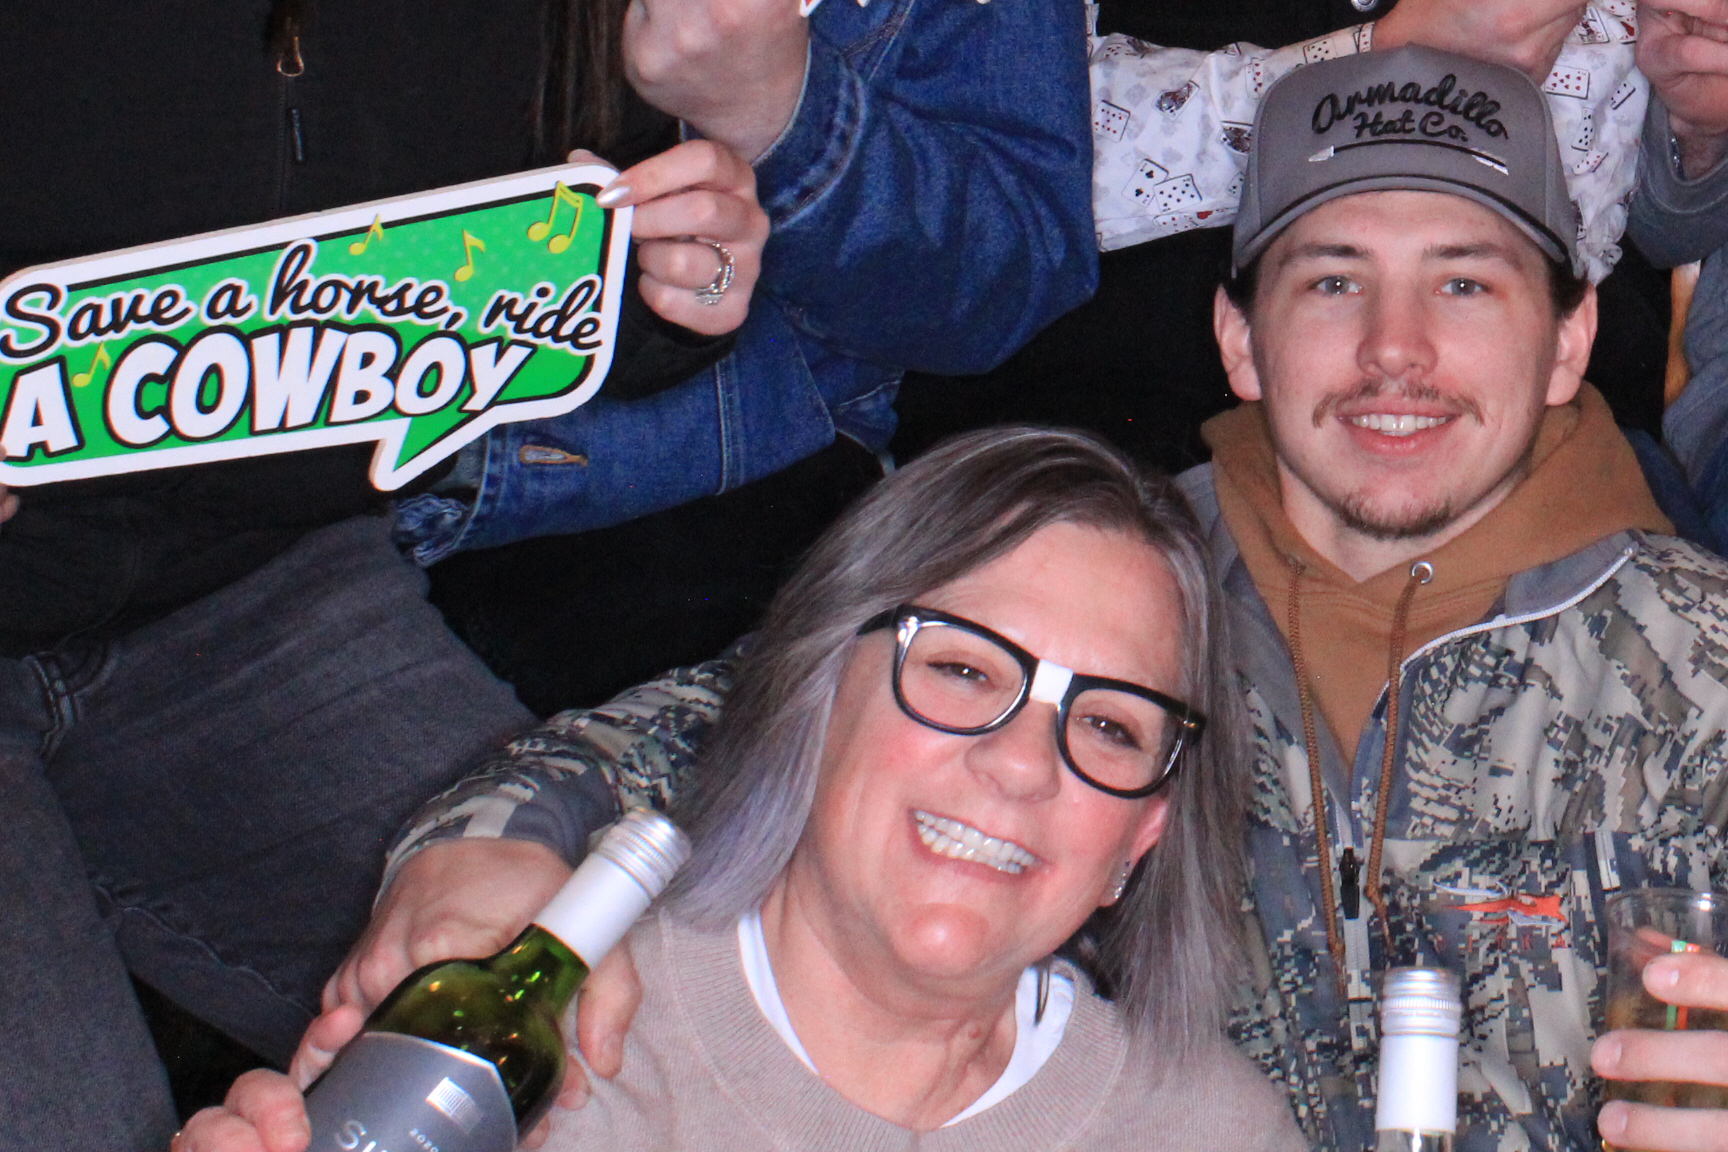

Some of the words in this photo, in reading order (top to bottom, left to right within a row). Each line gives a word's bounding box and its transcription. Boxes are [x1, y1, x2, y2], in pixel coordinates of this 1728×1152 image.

[1311, 73, 1510, 140] Armadillo
[1353, 109, 1416, 139] Hat
[1418, 111, 1468, 142] Co.
[1, 283, 189, 357] Save
[206, 278, 253, 319] a
[268, 239, 466, 331] horse,
[484, 277, 604, 350] ride
[0, 359, 83, 459] A
[104, 323, 536, 445] COWBOY
